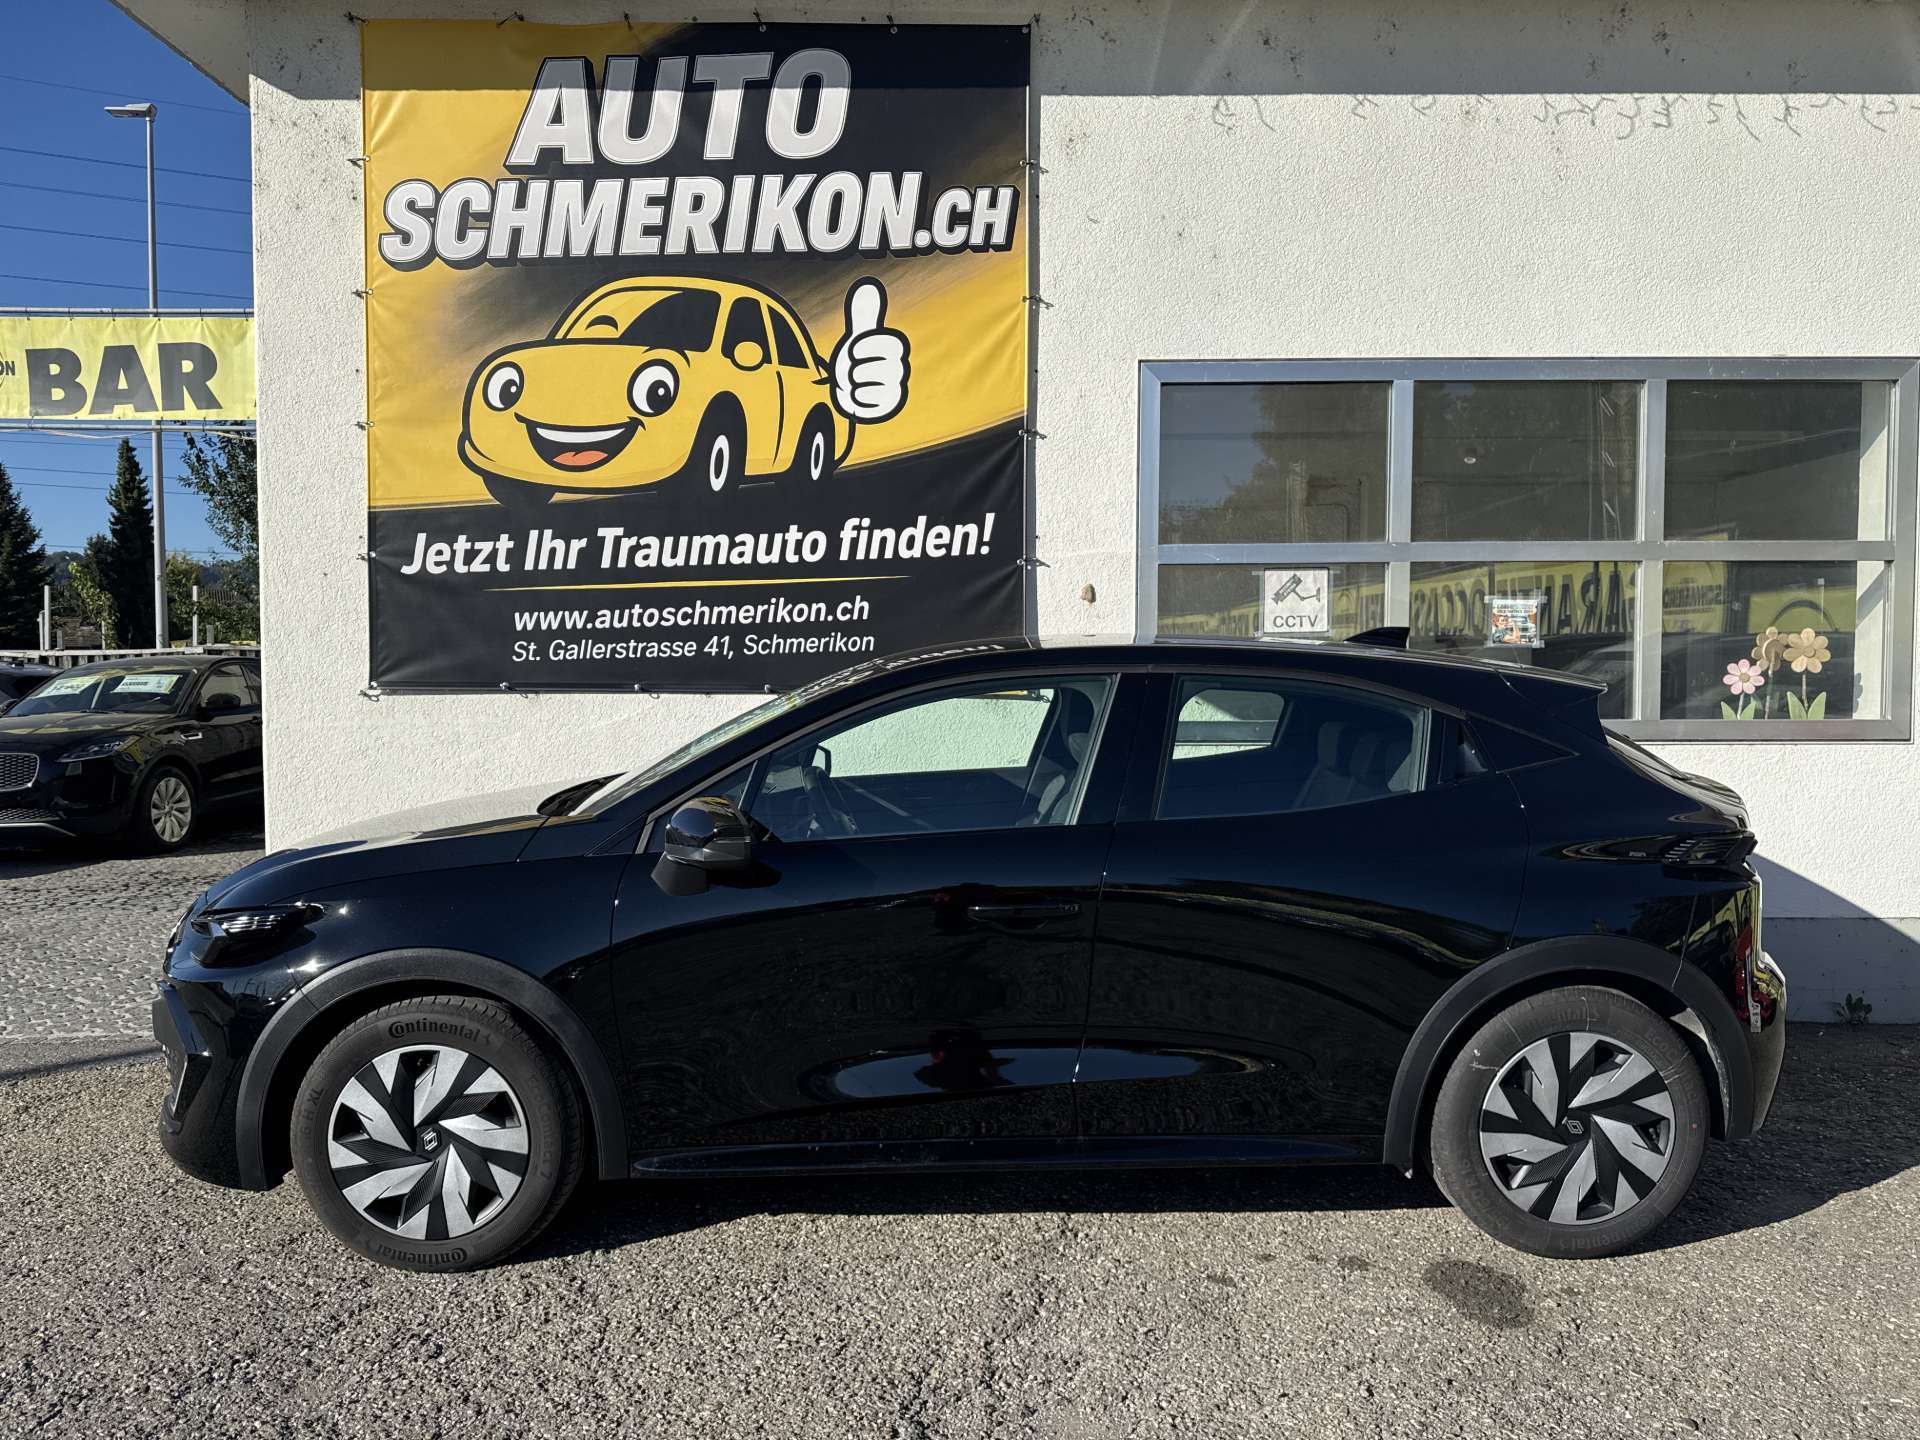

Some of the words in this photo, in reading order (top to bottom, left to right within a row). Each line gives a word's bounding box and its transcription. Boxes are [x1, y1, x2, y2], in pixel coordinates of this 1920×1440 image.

[504, 48, 851, 167] AUTO
[379, 171, 1015, 263] SCHMERIKON.CH
[25, 341, 223, 417] BAR
[400, 531, 511, 575] Jetzt
[524, 528, 588, 571] Ihr
[596, 524, 827, 569] Traumauto
[839, 512, 997, 562] finden!
[514, 594, 870, 632] www.autoschmerikon.ch
[1272, 615, 1318, 628] CCTV
[512, 640, 541, 662] St.
[549, 637, 697, 661] Gallerstrasse
[703, 635, 734, 659] 41,
[743, 631, 875, 656] Schmerikon
[387, 1018, 481, 1043] Continental
[376, 1244, 468, 1265] Continental
